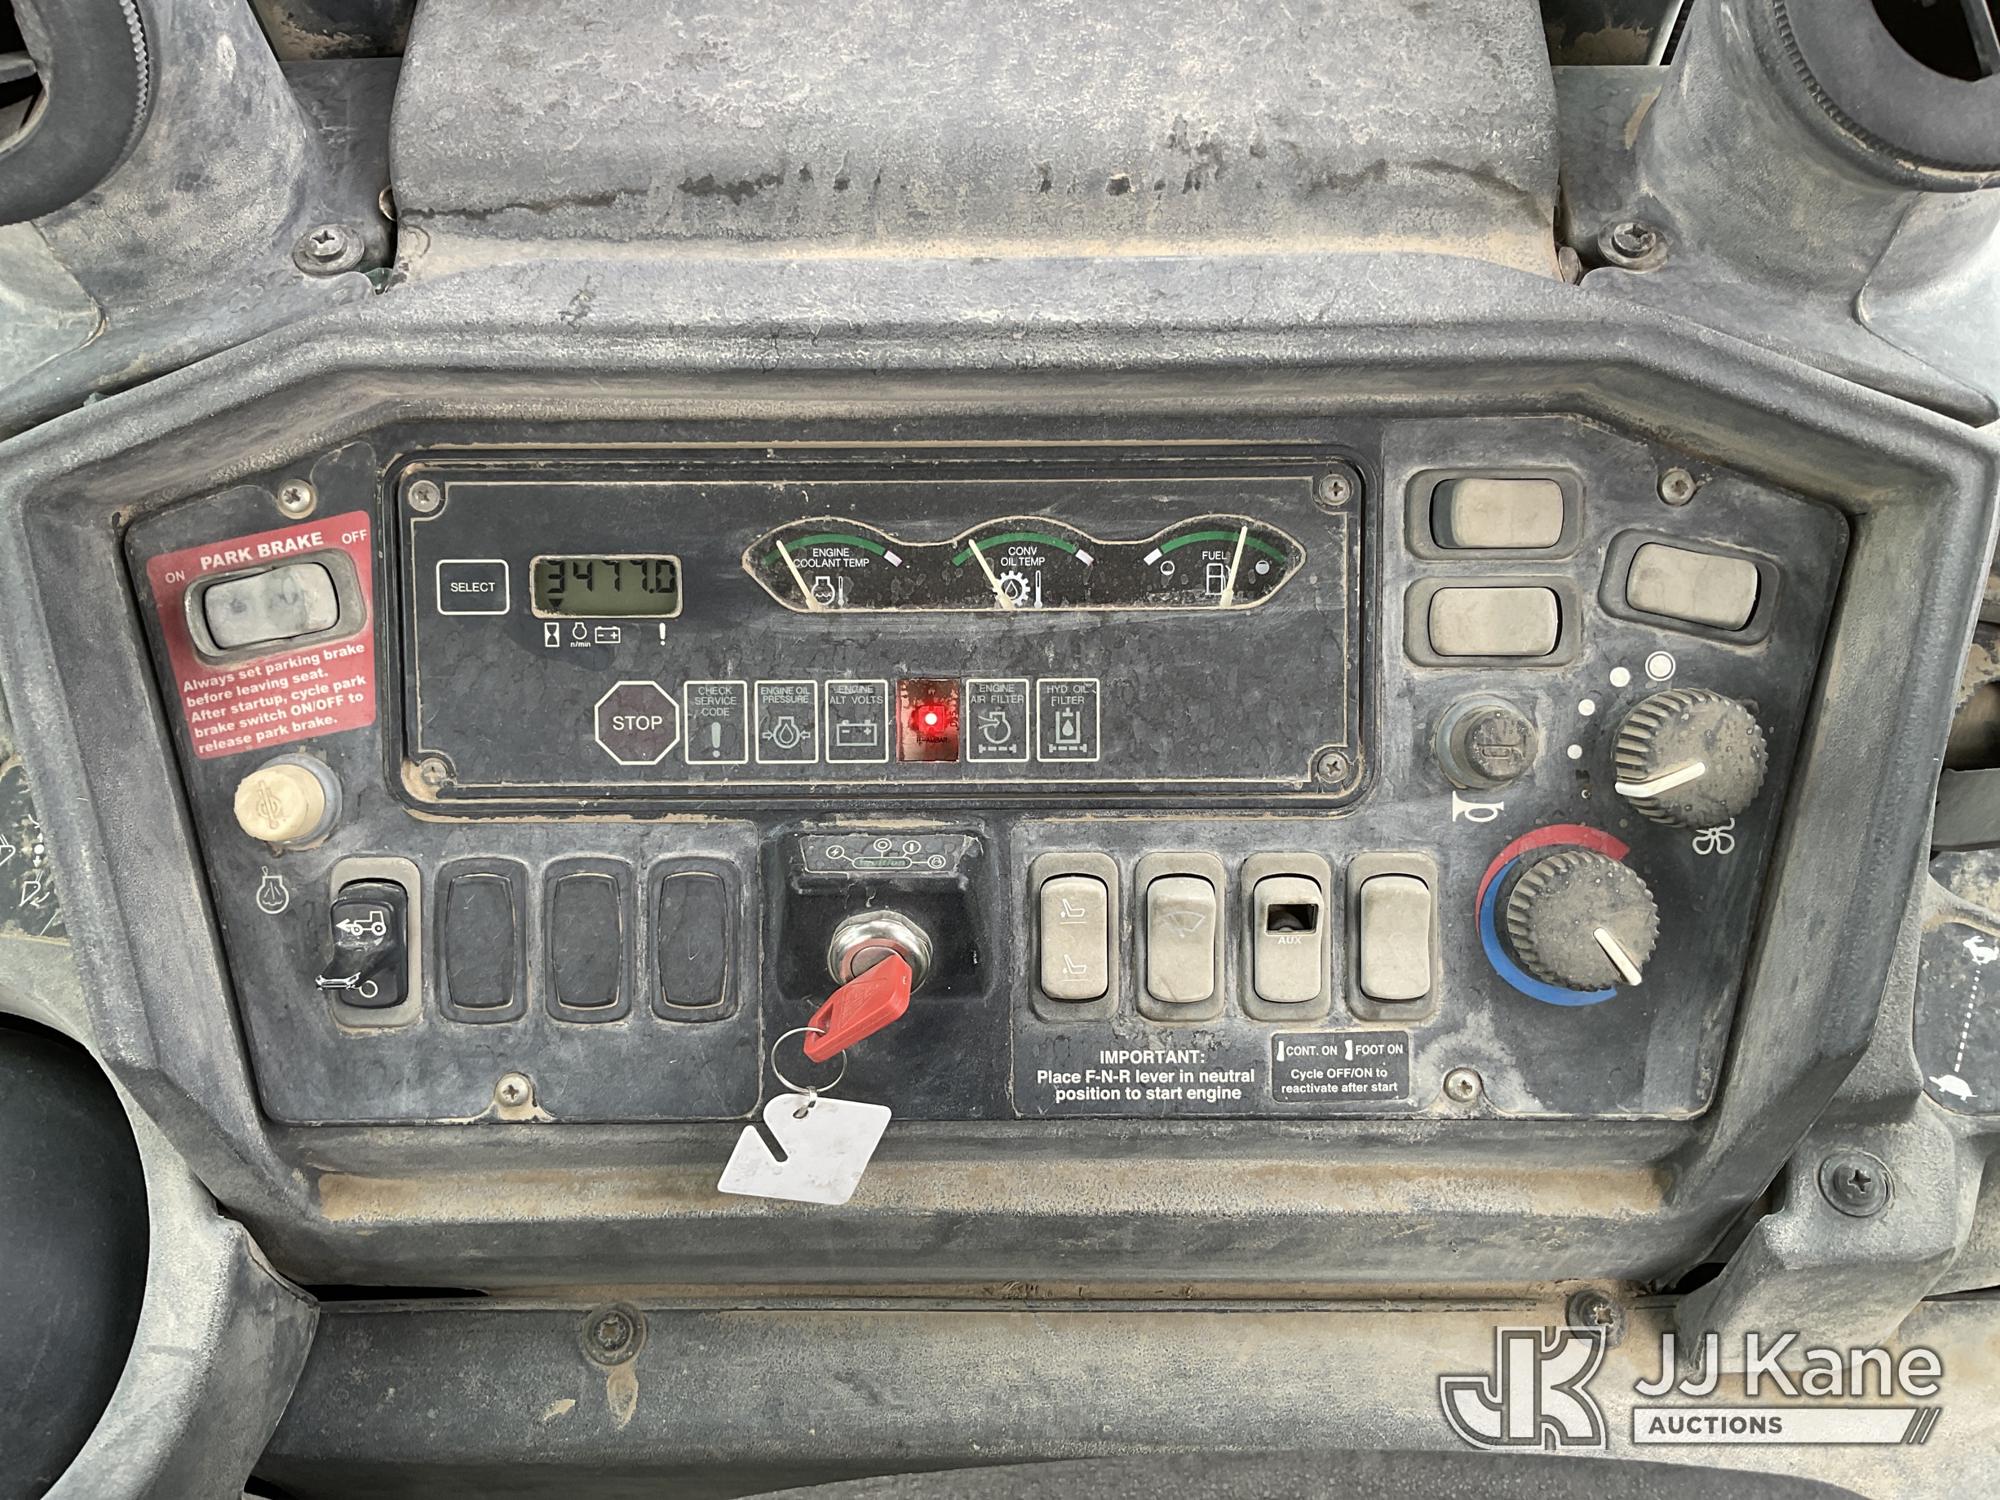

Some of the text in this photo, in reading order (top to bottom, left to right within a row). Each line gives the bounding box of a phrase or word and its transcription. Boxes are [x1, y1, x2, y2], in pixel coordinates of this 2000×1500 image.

[341, 529, 368, 545] OFF
[200, 531, 324, 570] PARK BRAKE
[812, 548, 850, 557] ENGINE
[1008, 546, 1037, 556] CONV
[1202, 551, 1227, 560] FUEL
[793, 558, 869, 568] COOLANT TEMP
[1000, 557, 1046, 566] OIL TEMP
[165, 570, 185, 584] ON
[547, 560, 676, 594] 3477.0
[450, 582, 496, 593] SELECT
[183, 643, 365, 692] Always set parking brake
[187, 668, 329, 707] before leaving seat.
[698, 686, 733, 695] CHECK
[760, 686, 811, 695] ENGINE OIL
[839, 685, 874, 693] ENGINE
[979, 684, 1015, 693] ENGINE
[1046, 685, 1089, 694] HYD OIL
[191, 674, 367, 723] After startup, cycle park
[694, 697, 737, 706] SERVICE
[763, 695, 809, 704] PRESSURE
[829, 696, 884, 704] ALT VOLTS
[970, 695, 1024, 704] AIR FILTER
[1051, 696, 1085, 705] FILTER
[194, 692, 365, 738] brake switch ON/OFF to
[702, 708, 730, 717] CODE
[612, 715, 663, 731] STOP
[198, 716, 338, 753] release park brake.
[1277, 936, 1302, 944] AUX
[1286, 1045, 1338, 1056] CONT. ON
[1355, 1044, 1403, 1055] FOOT ON
[1100, 1050, 1206, 1064] IMPORTANT:
[1037, 1069, 1255, 1084] Place F-N-R lever in neutral
[1290, 1067, 1388, 1081] Cycle OFF/ON to
[1281, 1082, 1398, 1093] reactivate after start
[1055, 1086, 1242, 1103] position to start engine
